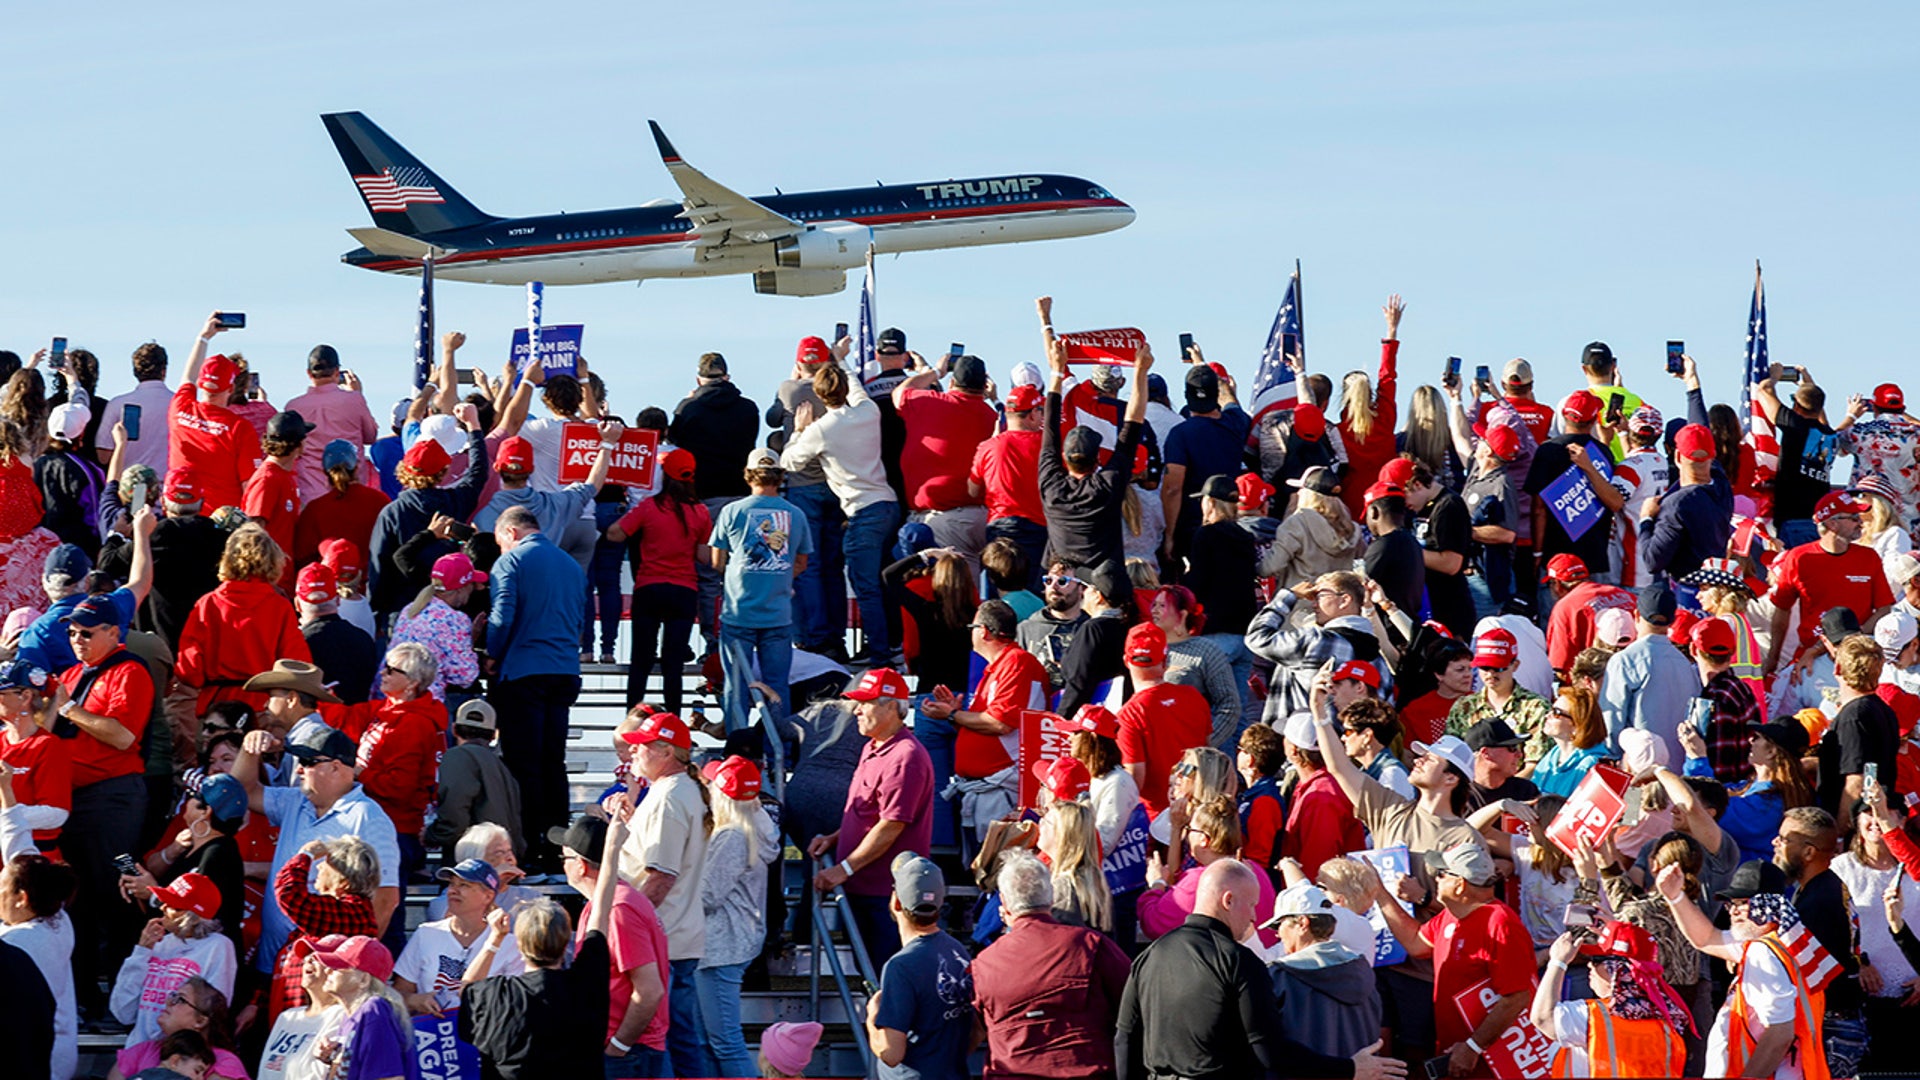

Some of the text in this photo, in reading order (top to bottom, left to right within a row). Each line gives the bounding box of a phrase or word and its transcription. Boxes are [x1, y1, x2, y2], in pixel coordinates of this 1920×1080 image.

[916, 177, 1043, 200] TRUMP
[514, 340, 579, 355] DRAM BIG,
[1067, 338, 1102, 347] WILL
[1103, 339, 1125, 349] FIX
[516, 353, 574, 371] AAIN!
[623, 443, 653, 457] BIG,
[1103, 842, 1147, 873] AIN!
[437, 1021, 462, 1080] DREA
